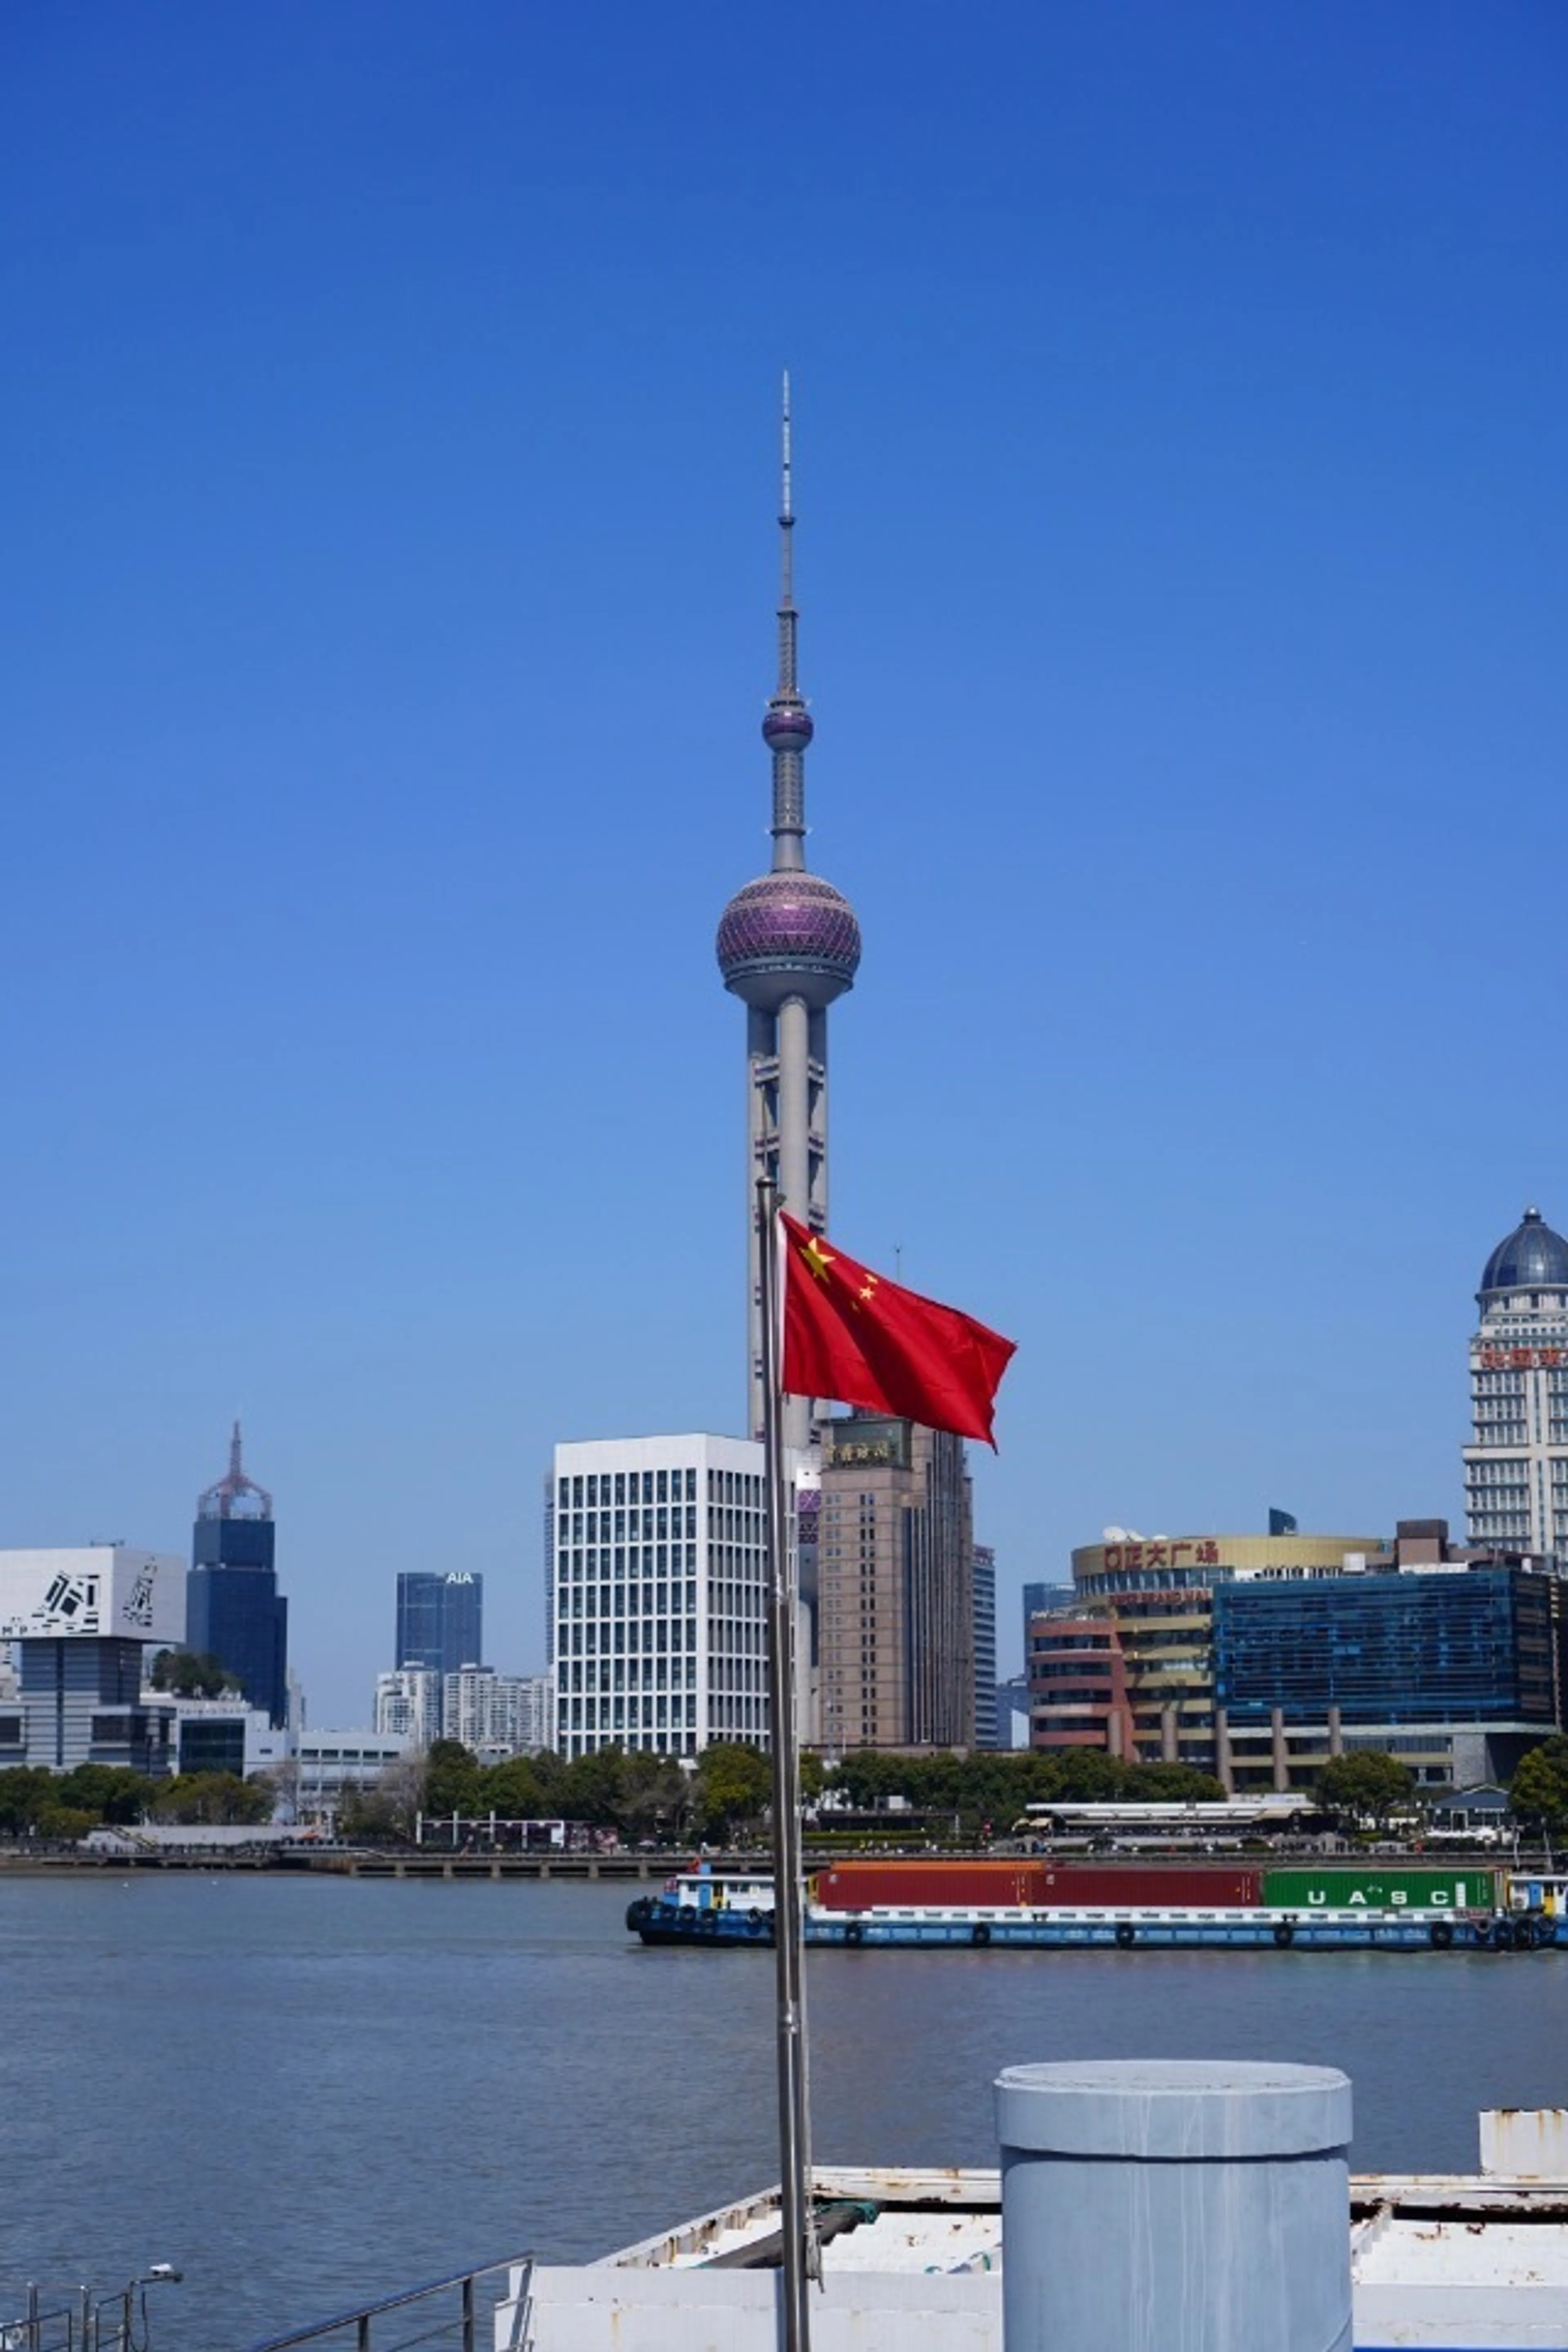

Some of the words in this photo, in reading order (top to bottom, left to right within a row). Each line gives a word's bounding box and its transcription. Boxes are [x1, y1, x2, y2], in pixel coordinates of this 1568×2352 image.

[1125, 1541, 1218, 1569] 正大广场
[446, 1572, 474, 1584] AIA
